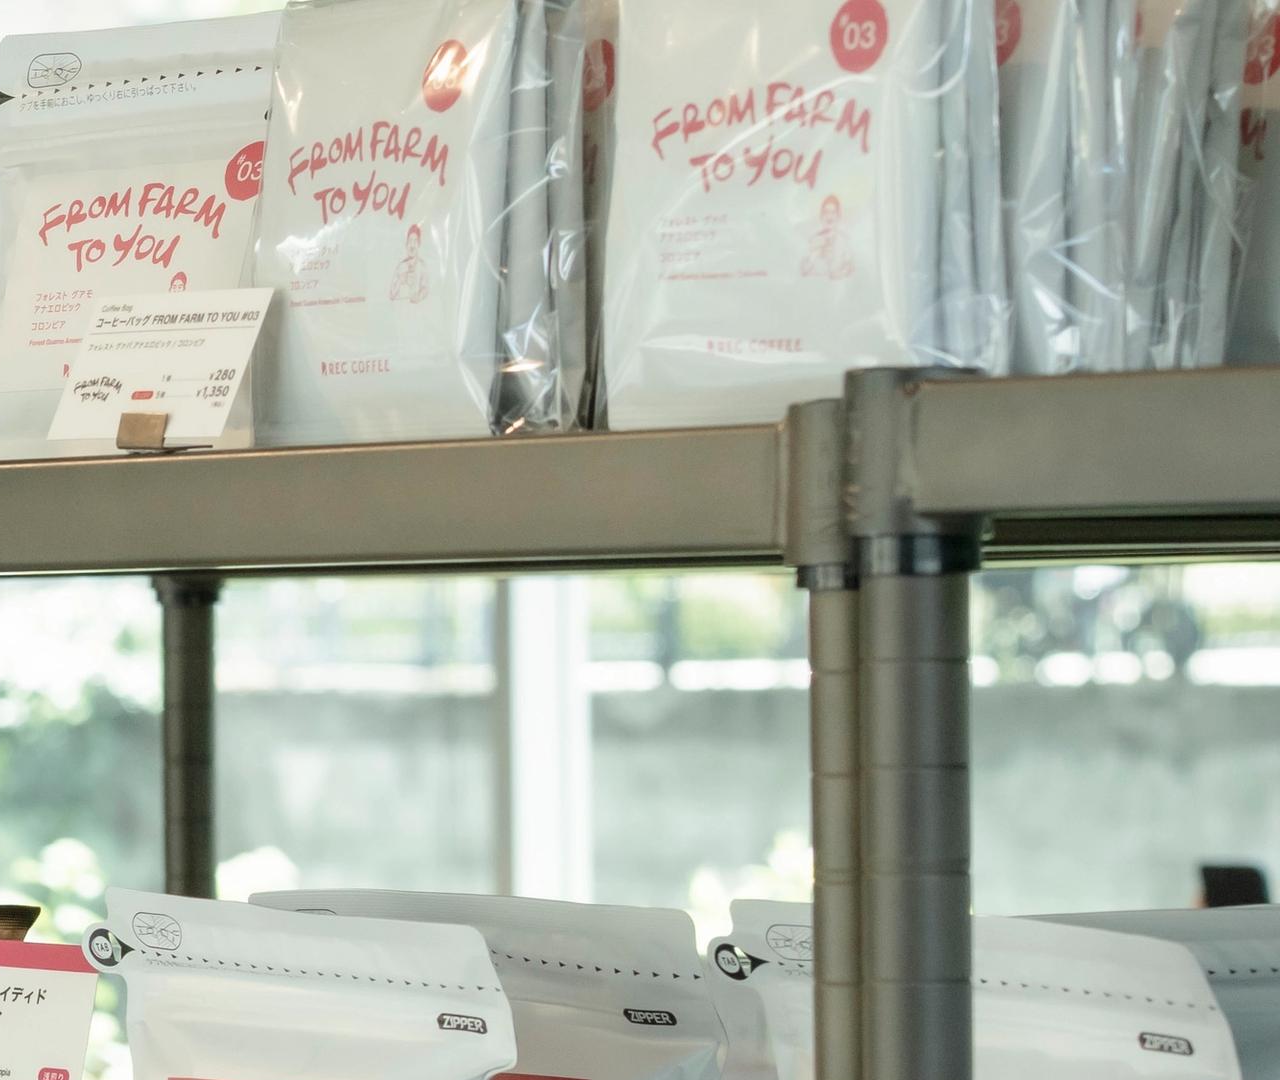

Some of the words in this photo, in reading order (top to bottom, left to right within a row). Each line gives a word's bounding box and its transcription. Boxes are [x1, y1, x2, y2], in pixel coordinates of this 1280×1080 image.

[652, 87, 756, 160] FROM
[767, 81, 871, 153] FARM
[288, 126, 364, 195] FROM
[370, 120, 448, 186] FARM
[689, 153, 735, 193] TO
[744, 134, 822, 191] YOU
[313, 187, 345, 224] TO
[352, 170, 411, 220] YOU
[38, 186, 132, 247] FROM
[138, 182, 226, 240] FARM
[67, 238, 107, 273] TO
[112, 224, 181, 269] YOU
[31, 321, 66, 331] コロンビア
[96, 314, 151, 329] コーヒーバッグ
[152, 316, 178, 326] FROM
[179, 314, 204, 324] FARM
[206, 313, 218, 323] TO
[220, 312, 240, 322] YOU
[241, 310, 260, 321] #03
[328, 361, 348, 375] REC
[73, 378, 99, 394] FROM
[100, 376, 123, 393] FARM
[95, 940, 110, 954] TAB
[0, 986, 47, 1005] イディド
[442, 1015, 484, 1032] ZIPPER
[627, 1010, 673, 1025] ZIPPER
